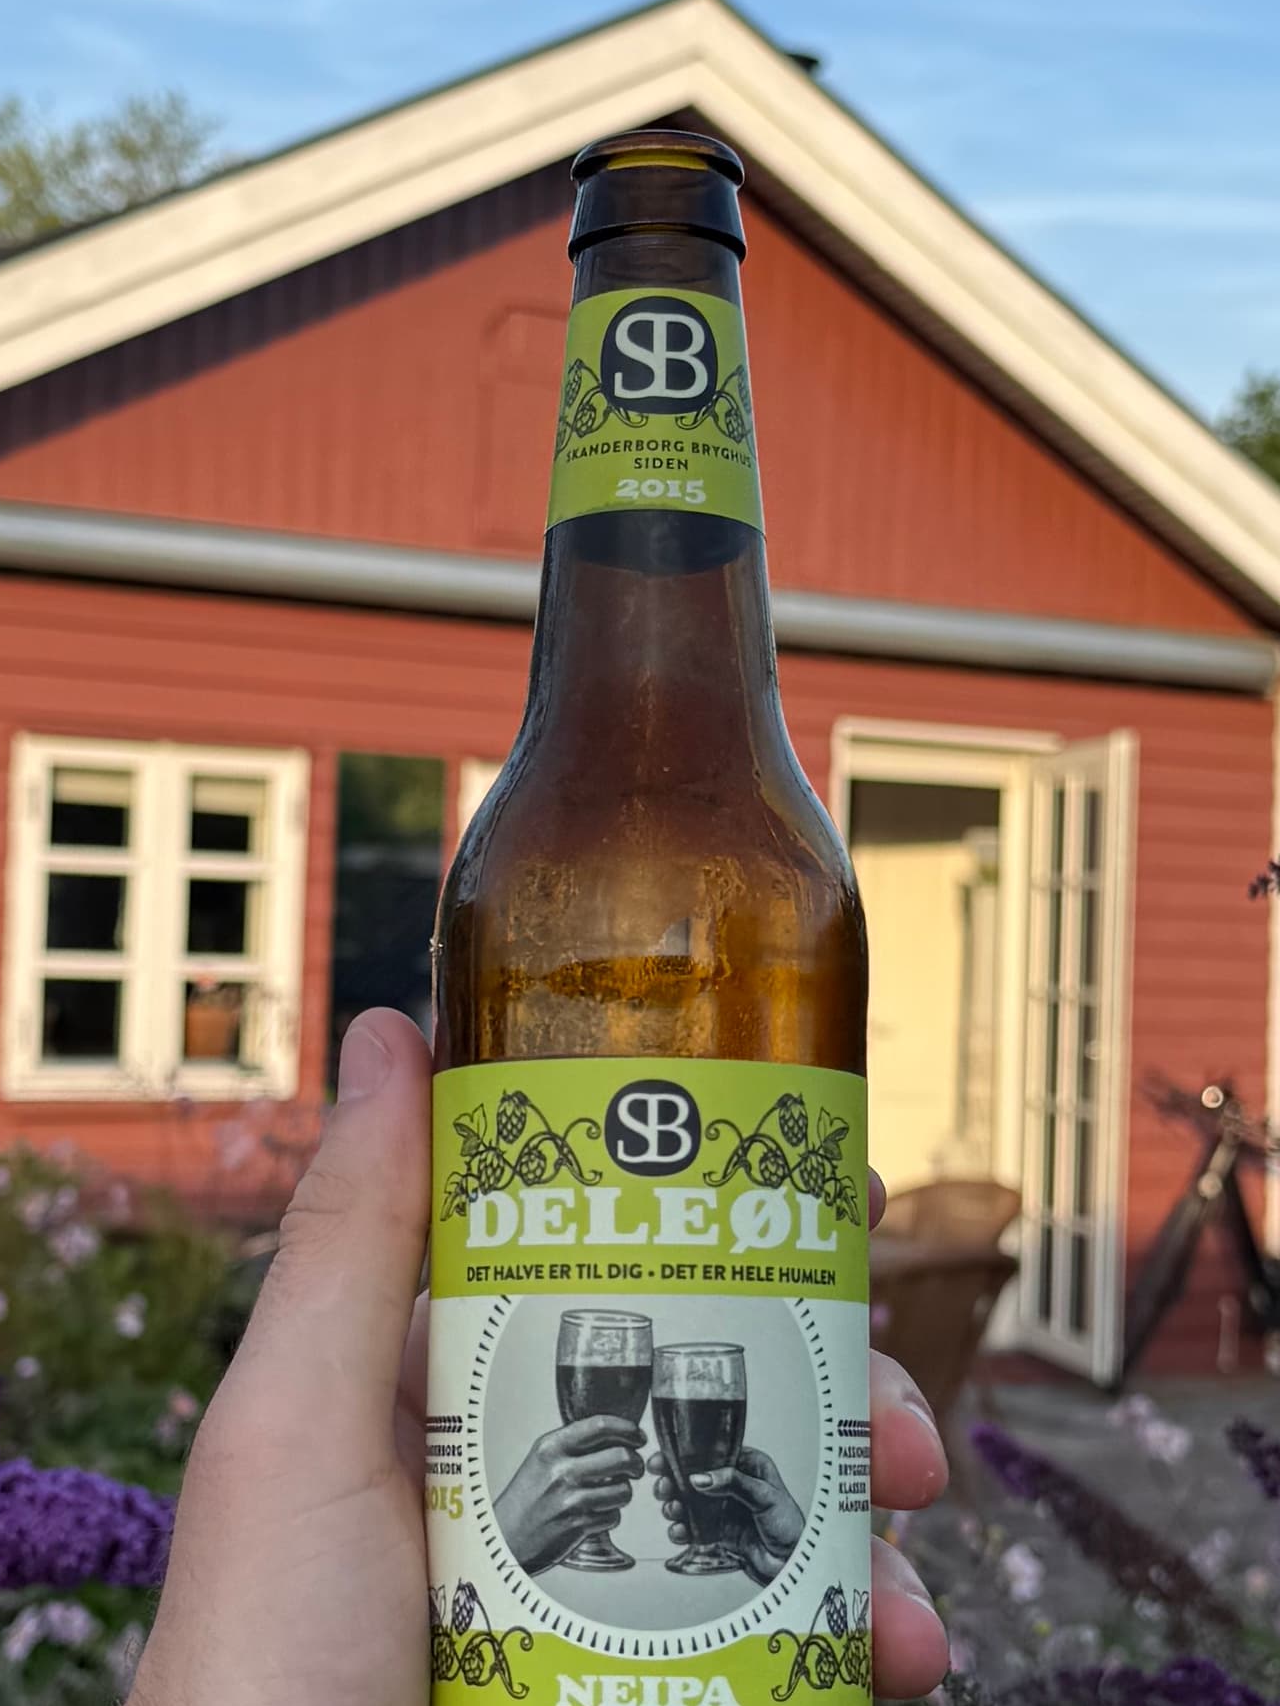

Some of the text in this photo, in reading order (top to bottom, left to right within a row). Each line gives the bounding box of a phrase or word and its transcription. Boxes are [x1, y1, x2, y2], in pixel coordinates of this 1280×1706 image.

[614, 311, 709, 399] SB
[566, 439, 752, 469] SKANDERBORG BRYGHUS
[633, 457, 689, 471] SIDEN
[615, 478, 707, 505] 2015
[616, 1092, 692, 1164] SB
[467, 1264, 836, 1285] DET HALVE ER TIL DIG DET ER HELE HUMLEN
